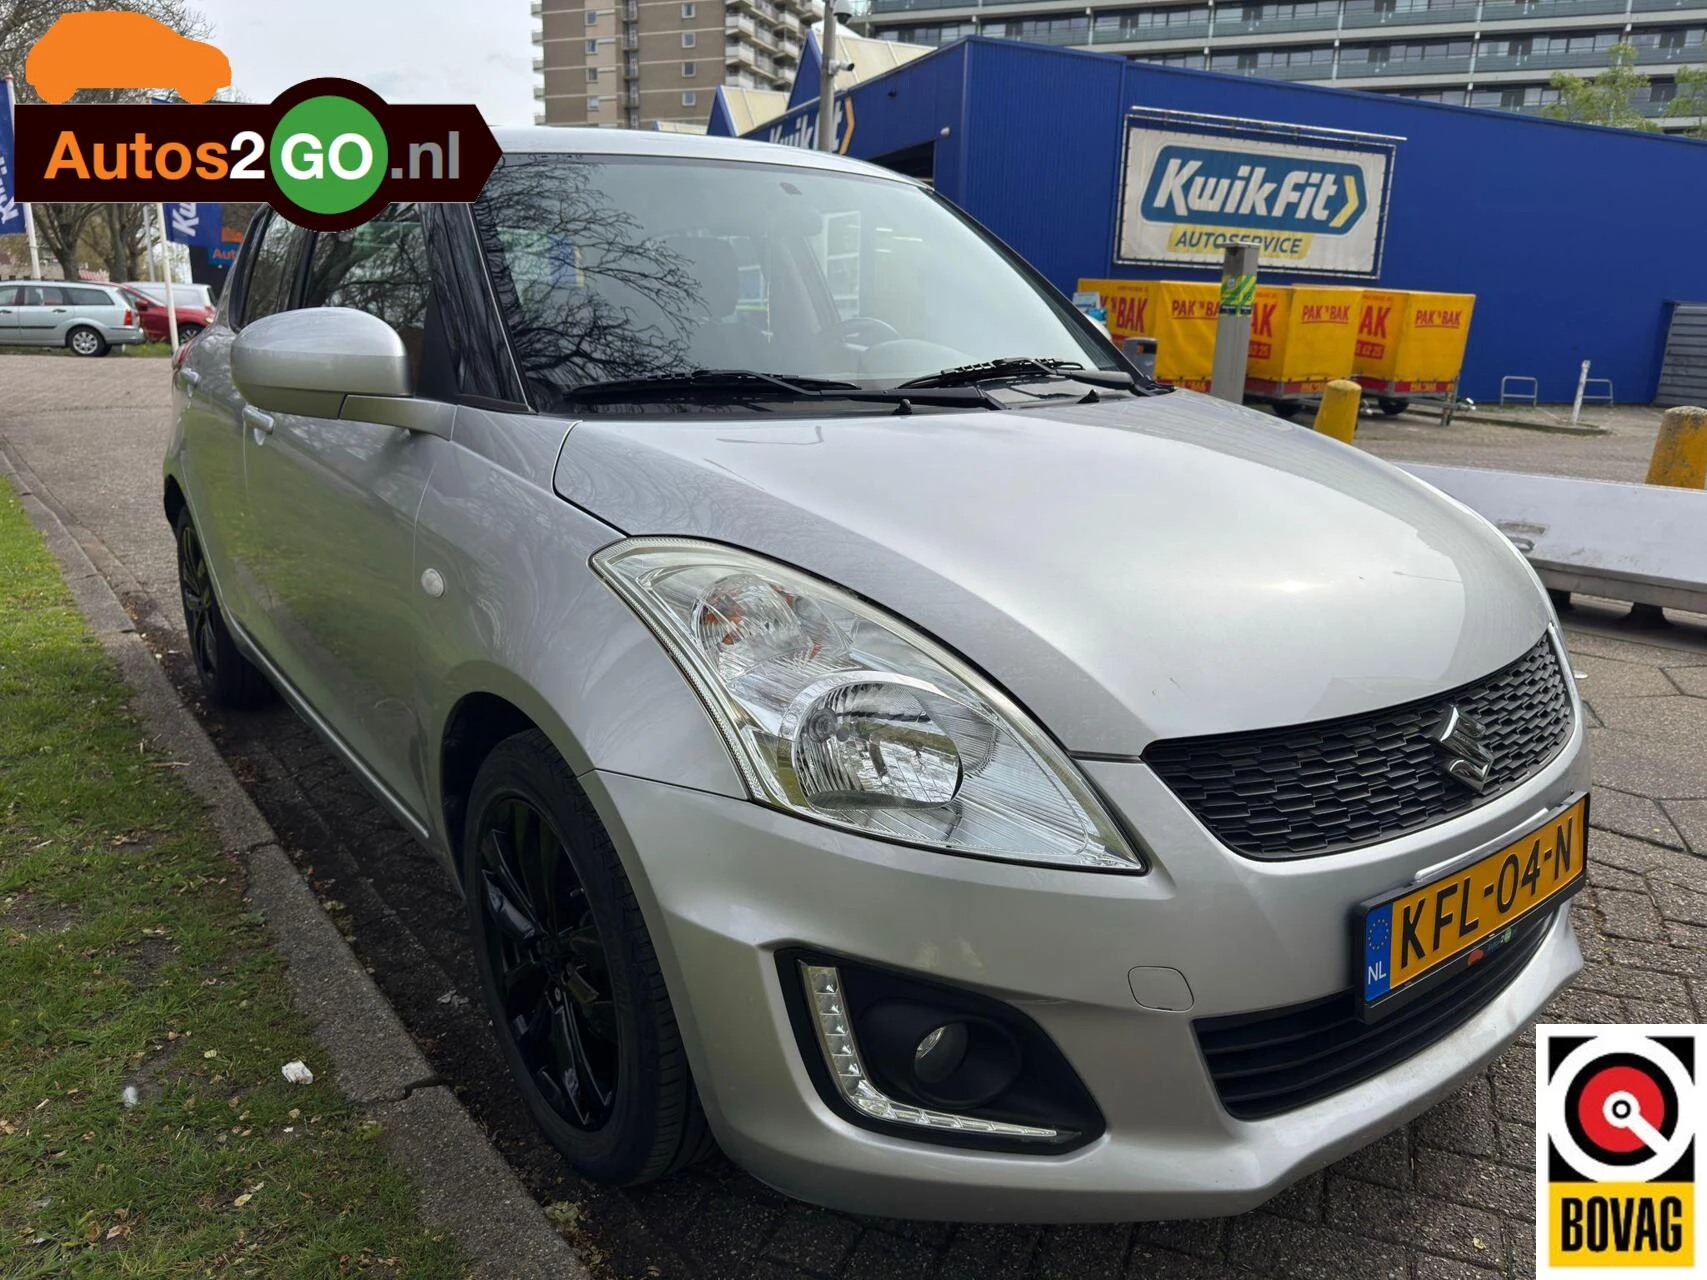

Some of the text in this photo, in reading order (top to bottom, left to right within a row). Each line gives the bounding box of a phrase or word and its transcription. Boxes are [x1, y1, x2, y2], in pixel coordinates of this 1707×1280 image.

[1171, 300, 1195, 316] PAK
[1251, 303, 1277, 338] AK
[1302, 304, 1323, 320] PAK
[1330, 305, 1350, 321] BAK
[1415, 310, 1435, 324] PAK
[1359, 305, 1391, 339] AK
[1401, 816, 1573, 969] KFL-04-N
[1367, 960, 1387, 985] NL
